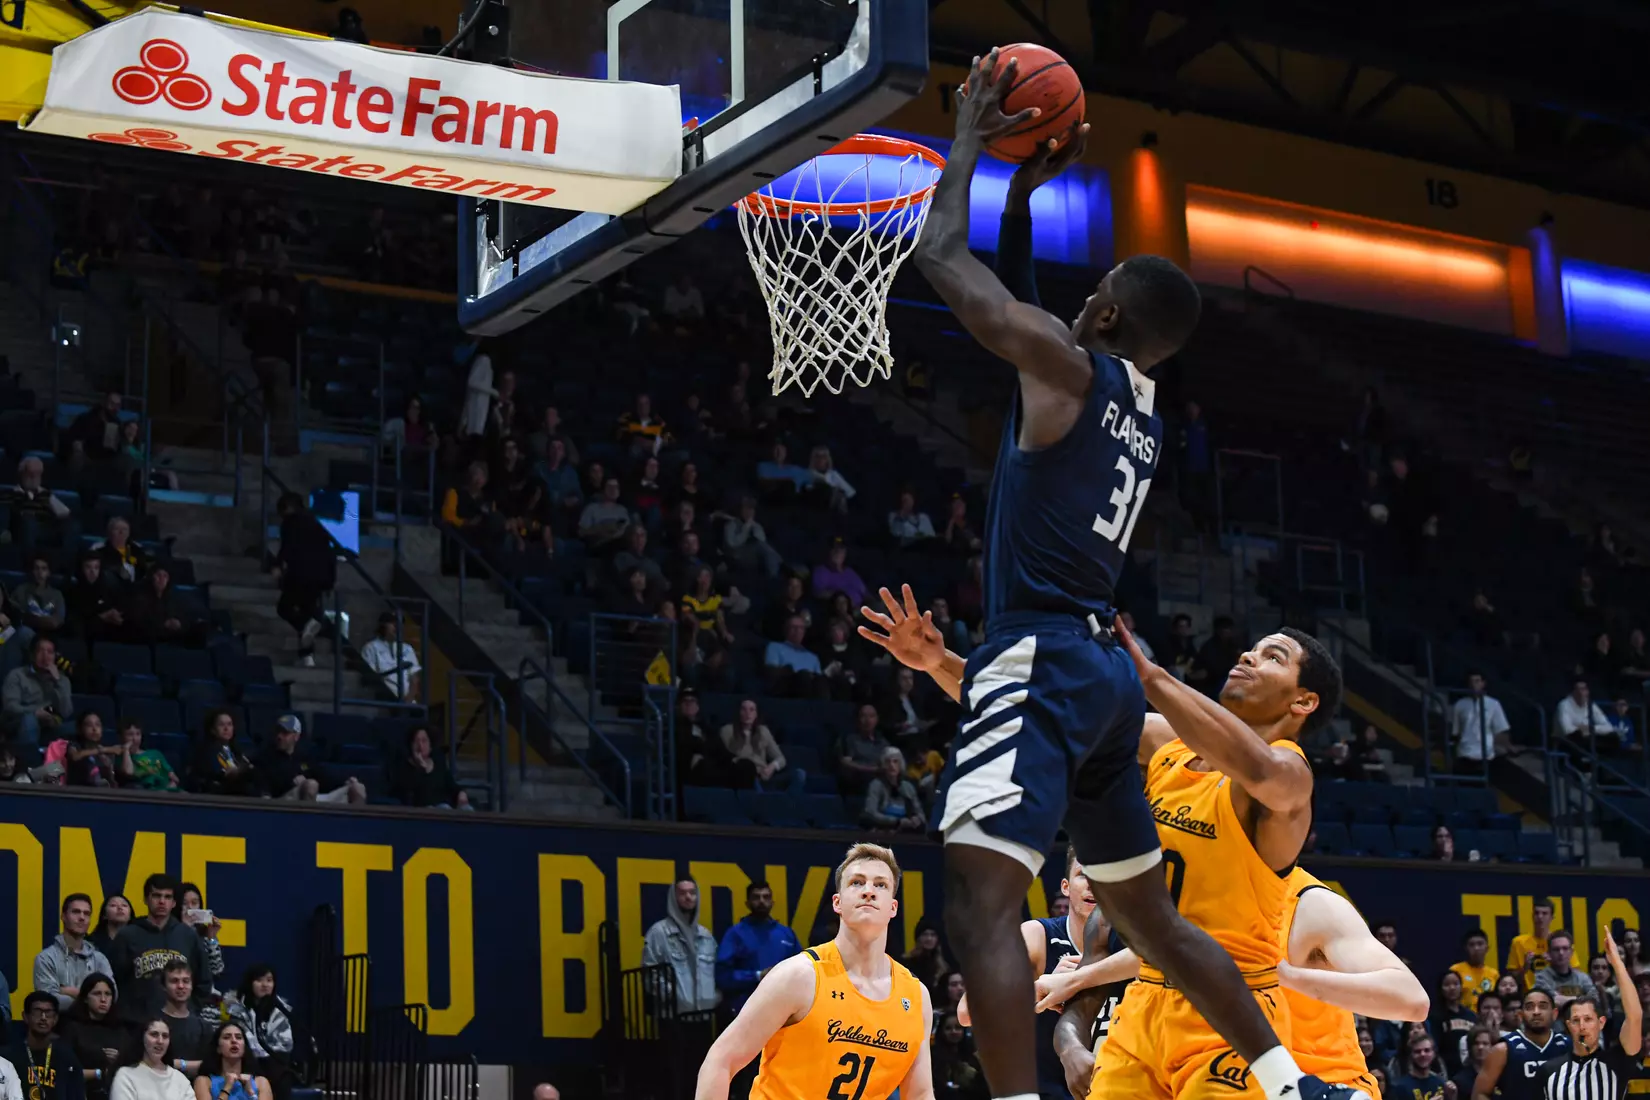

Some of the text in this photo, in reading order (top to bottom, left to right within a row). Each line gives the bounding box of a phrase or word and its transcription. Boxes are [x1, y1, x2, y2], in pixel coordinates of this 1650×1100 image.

[1425, 178, 1459, 209] 18
[1092, 454, 1153, 554] 31
[1171, 805, 1216, 836] Bears
[316, 841, 475, 1036] TO
[828, 1019, 909, 1050] Golden Bears
[827, 1052, 876, 1100] 21
[1205, 1048, 1252, 1090] Cal
